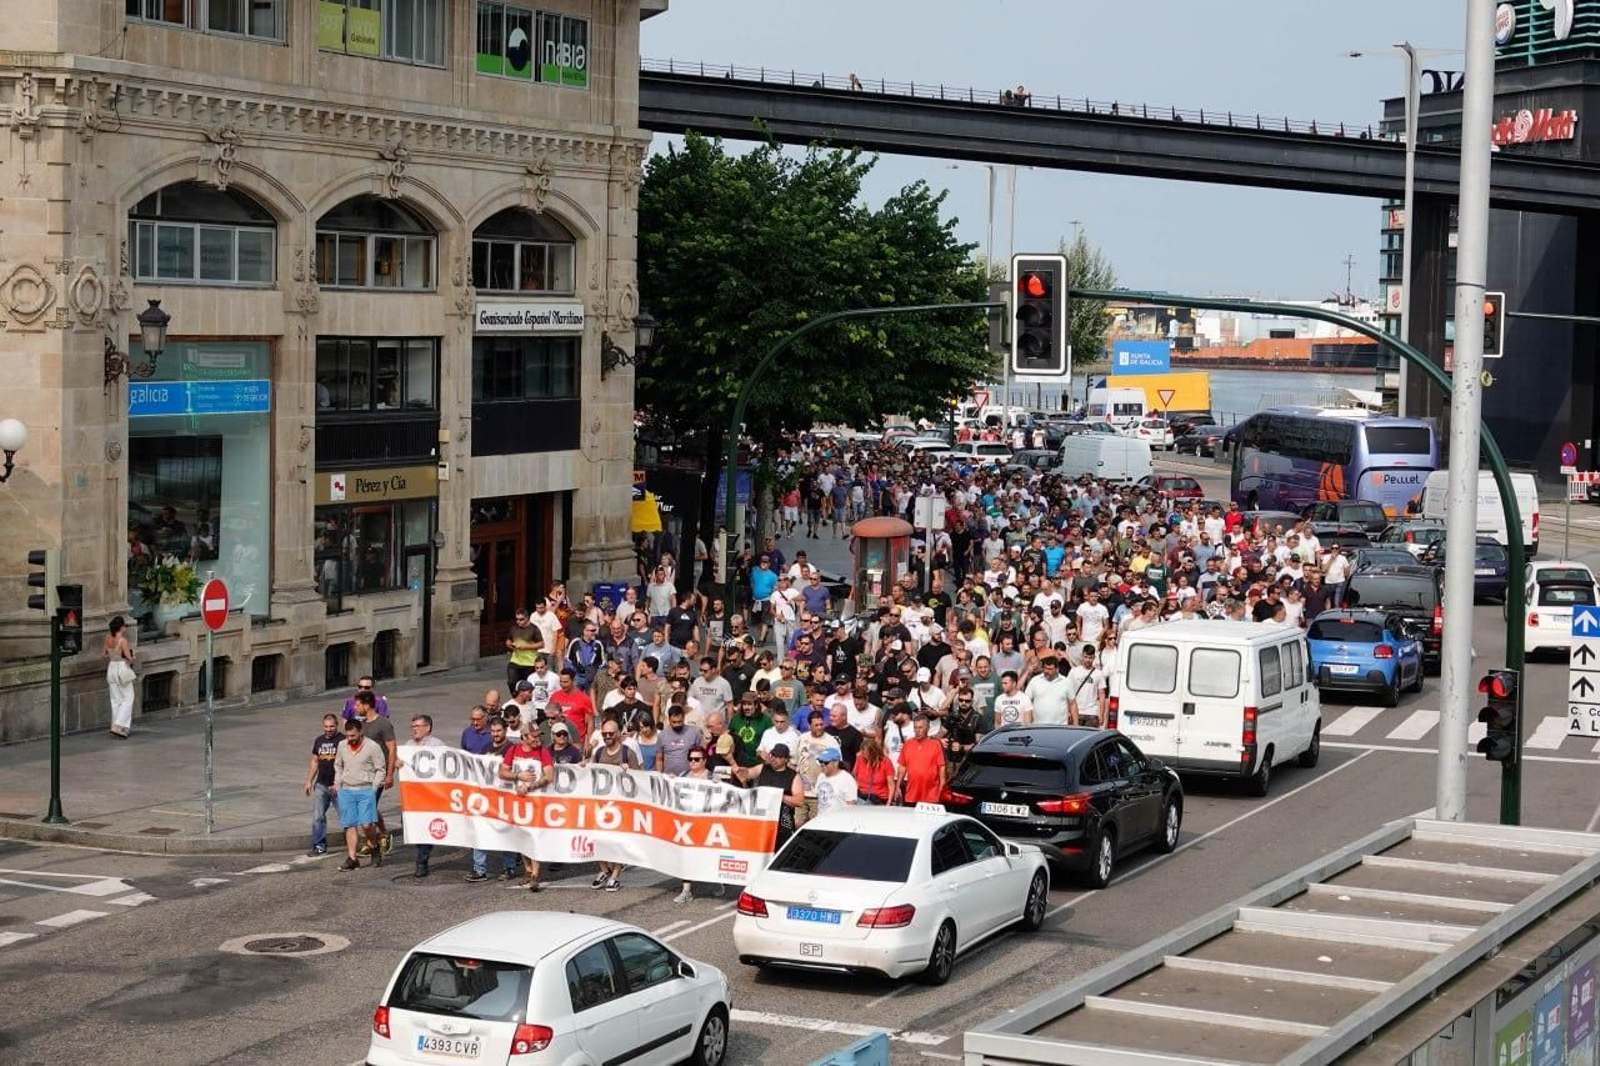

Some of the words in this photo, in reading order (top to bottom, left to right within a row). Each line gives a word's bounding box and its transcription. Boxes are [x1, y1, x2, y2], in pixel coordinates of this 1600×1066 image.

[356, 478, 380, 493] Pérez
[383, 480, 390, 496] y
[391, 475, 406, 490] Cía
[1570, 719, 1581, 731] A
[591, 766, 639, 799] DO
[650, 774, 767, 817] METAL
[450, 788, 653, 834] SOLUCIÓN
[988, 804, 1008, 814] 3306
[720, 860, 747, 872] CCOO
[794, 908, 817, 920] 3370
[802, 944, 820, 955] SP
[424, 1037, 452, 1052] 4393
[455, 1041, 479, 1056] CVR
